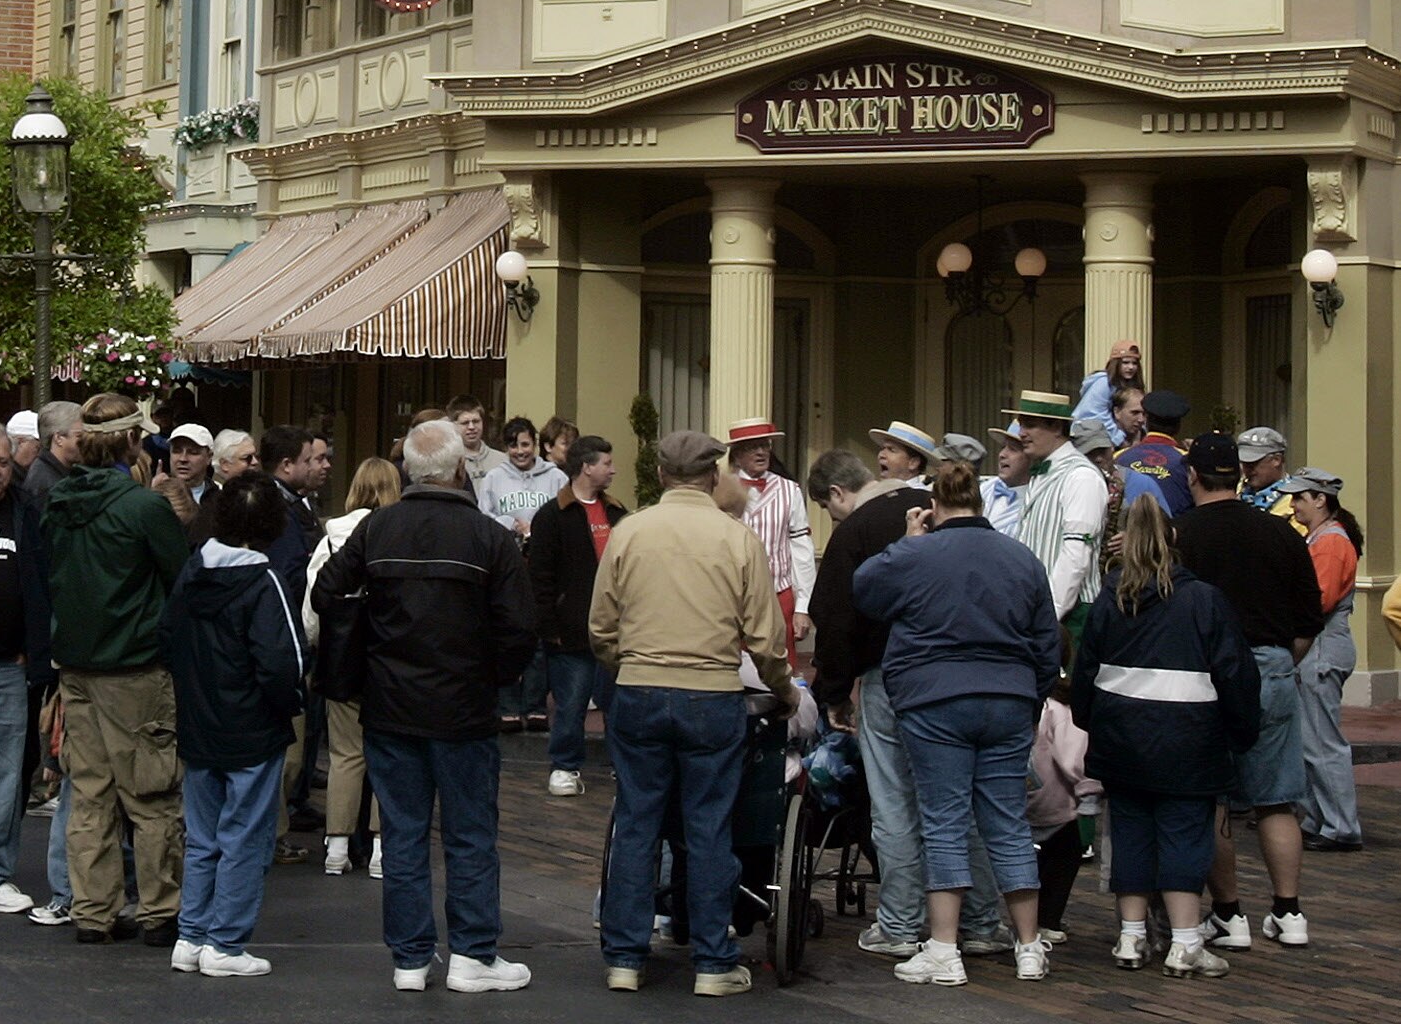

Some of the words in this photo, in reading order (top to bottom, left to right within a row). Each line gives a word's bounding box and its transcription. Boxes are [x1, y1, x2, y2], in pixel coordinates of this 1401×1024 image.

[814, 63, 896, 91] MAIN
[905, 62, 973, 88] STR.
[763, 95, 904, 136] MARKET
[910, 91, 1023, 131] HOUSE
